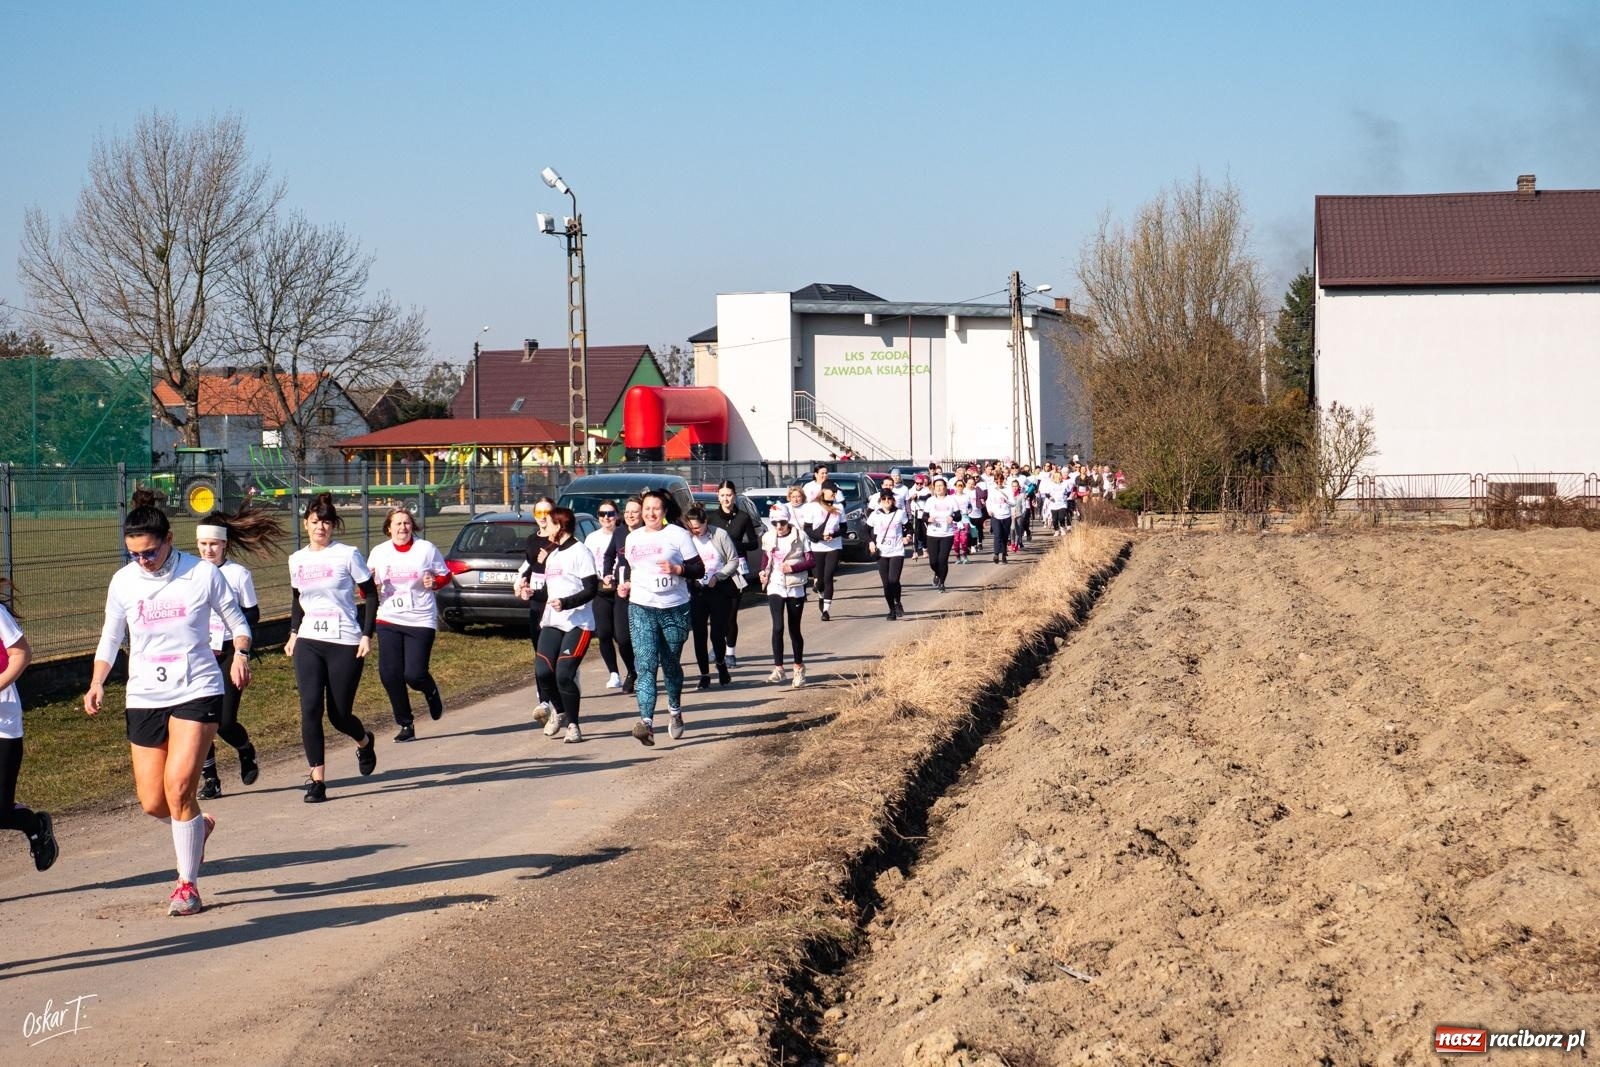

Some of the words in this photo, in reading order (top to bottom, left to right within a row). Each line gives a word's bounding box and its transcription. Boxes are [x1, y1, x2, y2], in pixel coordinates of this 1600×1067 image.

[845, 352, 865, 361] LKS
[870, 351, 910, 361] ZGODA
[823, 366, 873, 376] ZAWADA
[655, 576, 673, 588] 101
[147, 600, 172, 610] BIEG
[392, 597, 404, 608] 10
[147, 609, 180, 620] KOBIET
[313, 620, 329, 632] 44
[156, 666, 168, 682] 3
